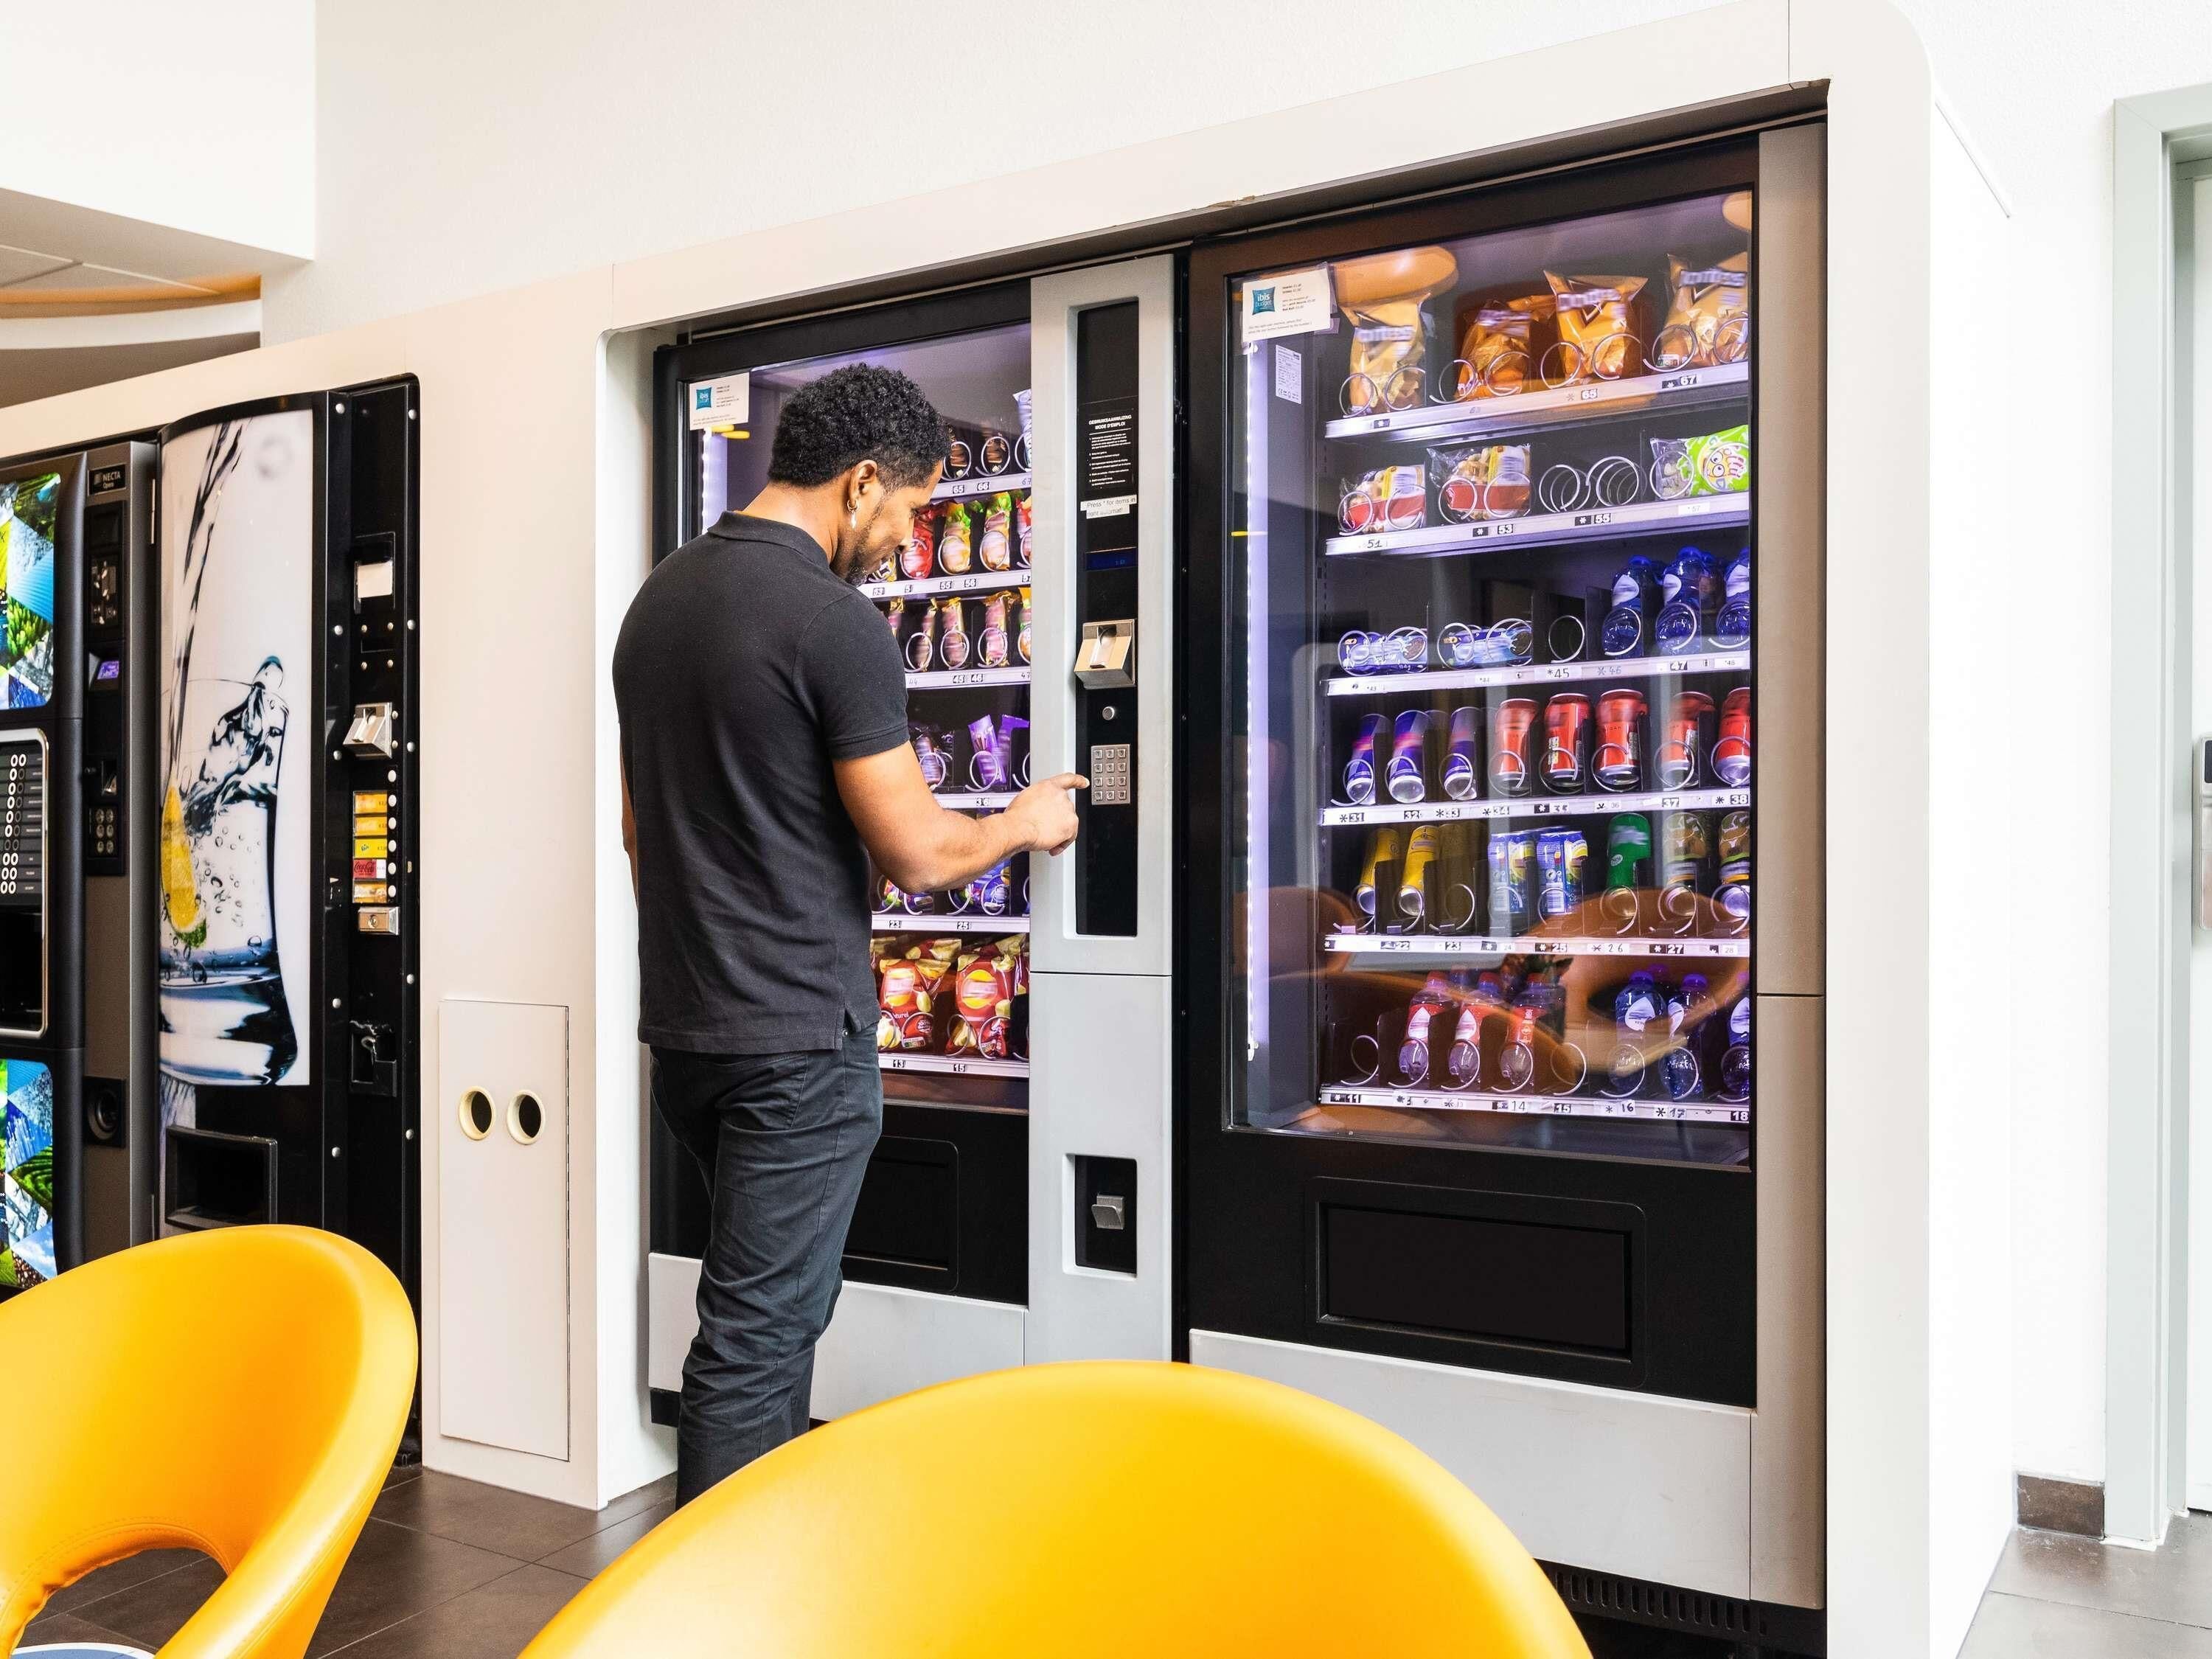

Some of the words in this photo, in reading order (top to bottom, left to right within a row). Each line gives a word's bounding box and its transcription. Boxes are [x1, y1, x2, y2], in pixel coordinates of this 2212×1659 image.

[1581, 389, 1598, 400] 65
[1680, 375, 1698, 386] 67
[103, 471, 121, 481] NECTA
[953, 485, 964, 494] 65
[977, 481, 990, 491] 66
[1367, 538, 1382, 549] 51
[1498, 524, 1513, 534] 53
[1594, 513, 1610, 524] 55
[940, 581, 952, 589] 55
[964, 579, 976, 587] 56
[1670, 661, 1688, 670] 47
[1663, 798, 1680, 808] 37
[1731, 795, 1748, 805] 38
[1667, 944, 1684, 954] 27
[1512, 1100, 1526, 1111] 14
[1554, 1103, 1571, 1113] 15
[1622, 1103, 1634, 1112] 16
[1731, 1110, 1749, 1121] 18
